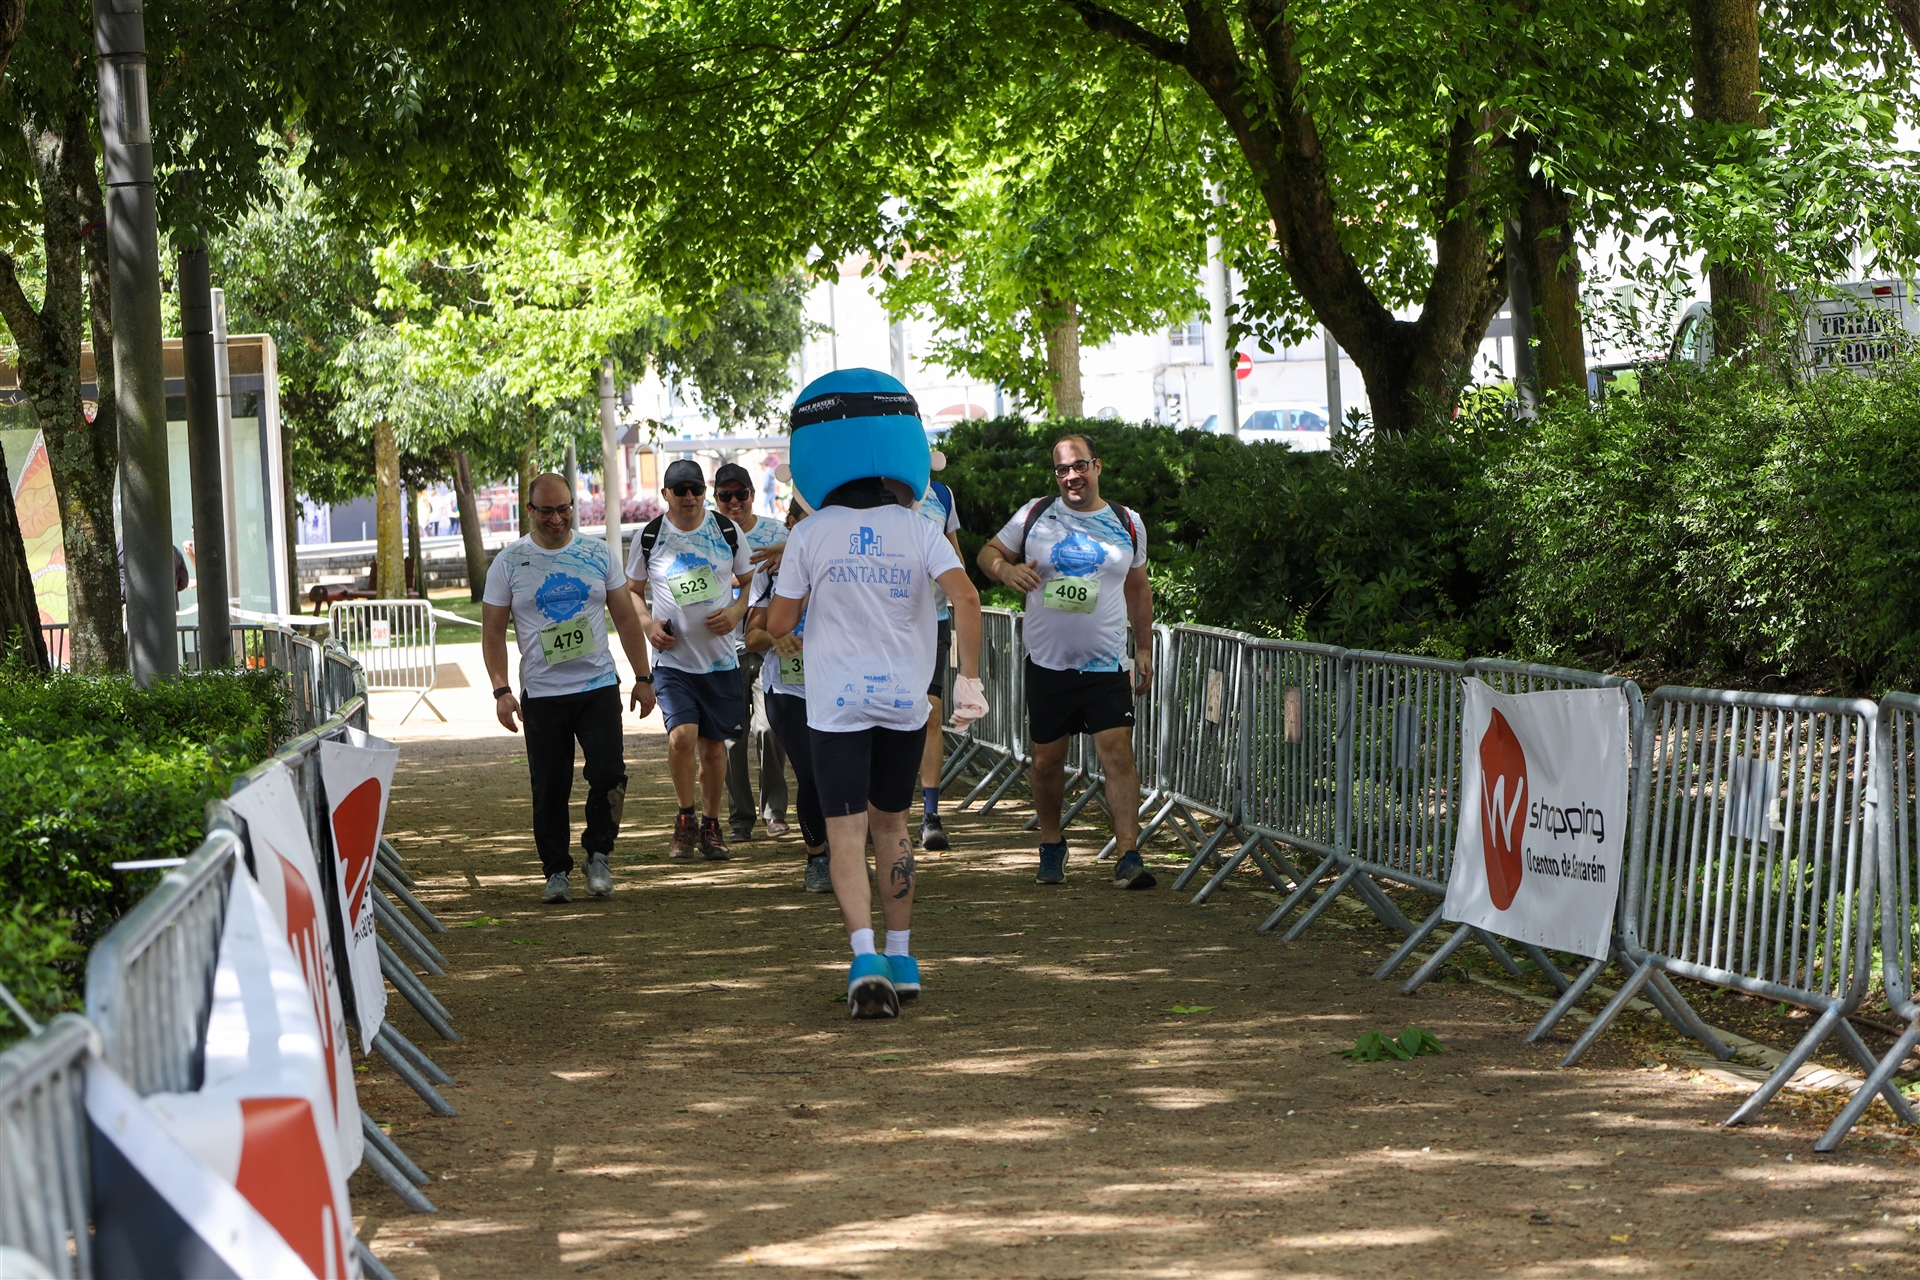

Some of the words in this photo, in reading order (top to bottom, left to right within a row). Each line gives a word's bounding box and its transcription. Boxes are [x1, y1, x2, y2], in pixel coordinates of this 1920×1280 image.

[829, 563, 912, 585] SANTARÉM
[680, 577, 708, 595] 523
[889, 588, 910, 599] TRAIL
[1055, 584, 1088, 602] 408
[372, 627, 387, 639] CMS
[553, 630, 584, 649] 479
[1481, 769, 1525, 852] W
[1529, 797, 1605, 844] shopping
[1526, 847, 1533, 872] O
[1532, 855, 1560, 877] centro
[1561, 853, 1572, 878] de
[1570, 853, 1606, 883] Santarém
